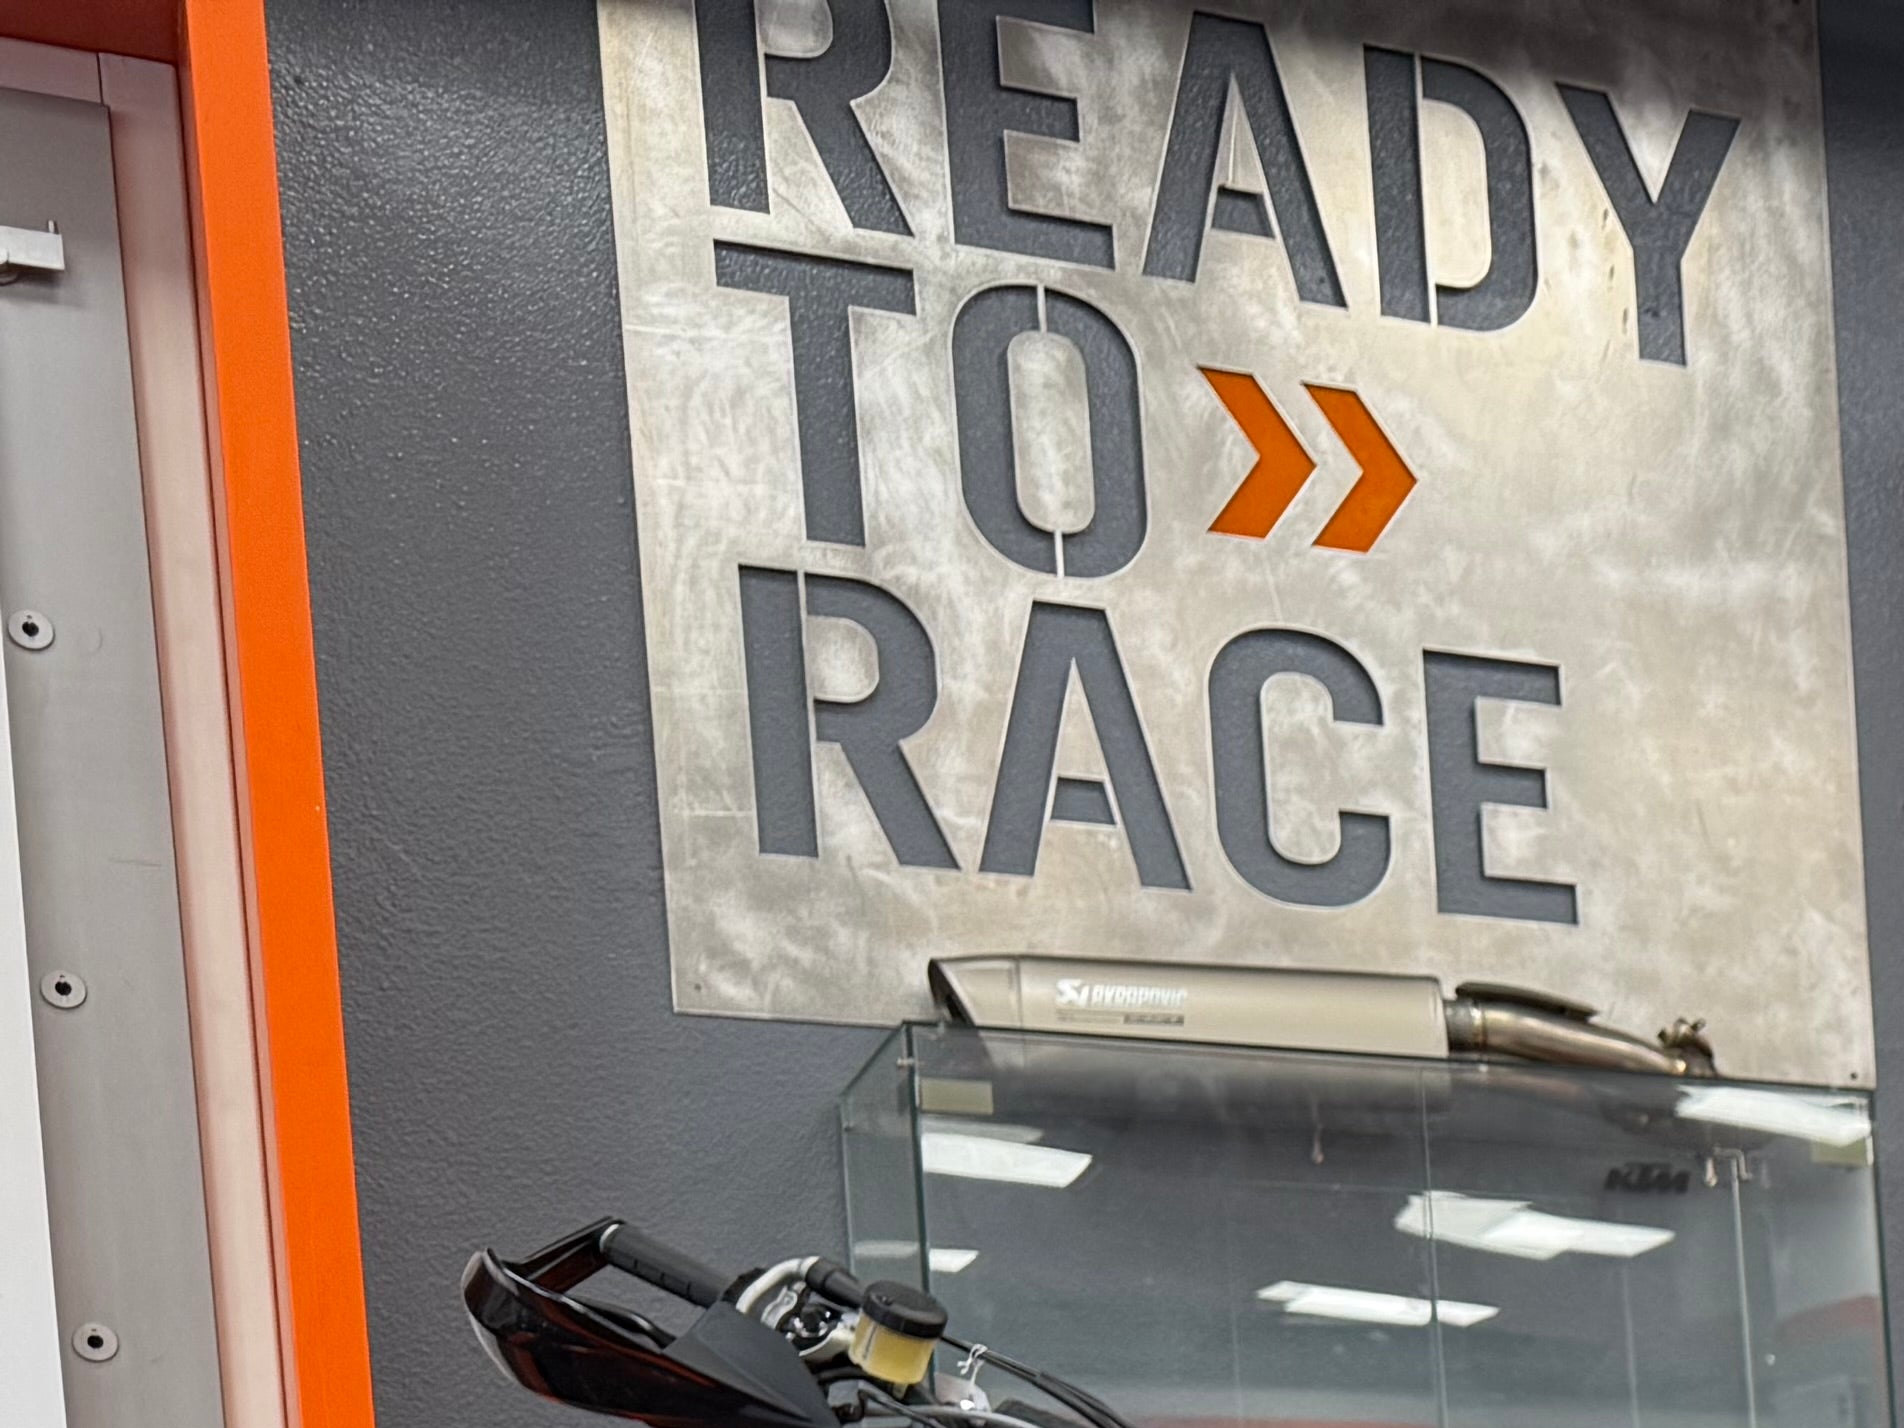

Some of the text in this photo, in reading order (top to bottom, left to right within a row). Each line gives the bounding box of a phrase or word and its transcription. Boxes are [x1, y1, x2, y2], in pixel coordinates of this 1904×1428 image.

[695, 0, 1742, 367] READY
[713, 237, 1149, 579] TO
[738, 562, 1581, 927] RACE
